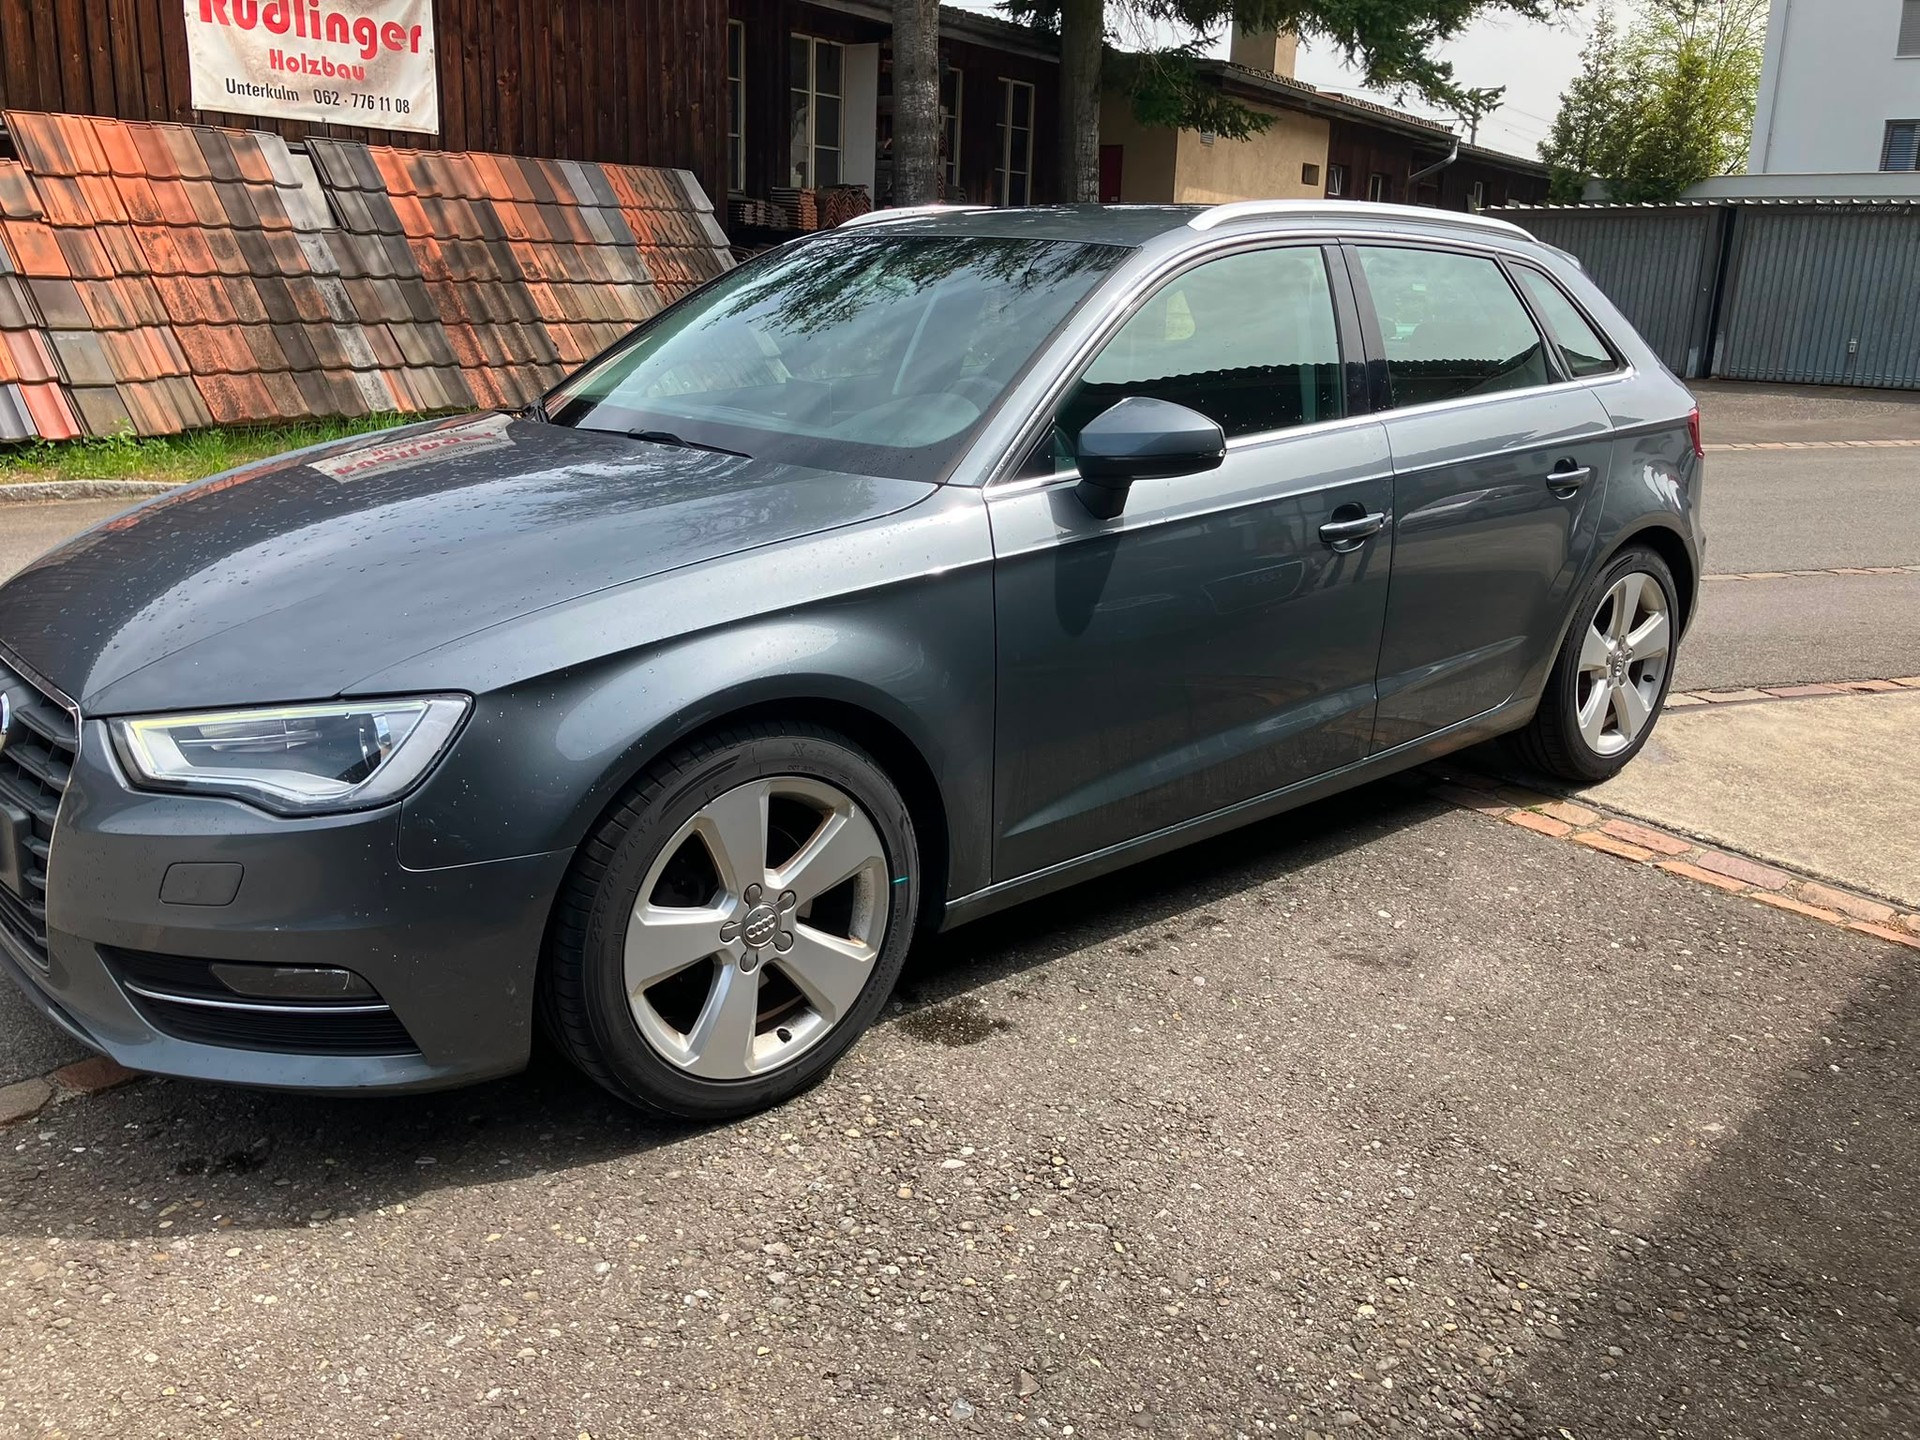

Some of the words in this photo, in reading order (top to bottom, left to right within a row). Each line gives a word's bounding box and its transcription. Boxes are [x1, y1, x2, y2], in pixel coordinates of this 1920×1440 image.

[269, 48, 365, 81] Holzbau
[226, 77, 300, 102] Unterkulm
[313, 88, 341, 106] 062
[351, 93, 375, 110] 776
[379, 97, 391, 112] 11
[395, 98, 411, 114] 08
